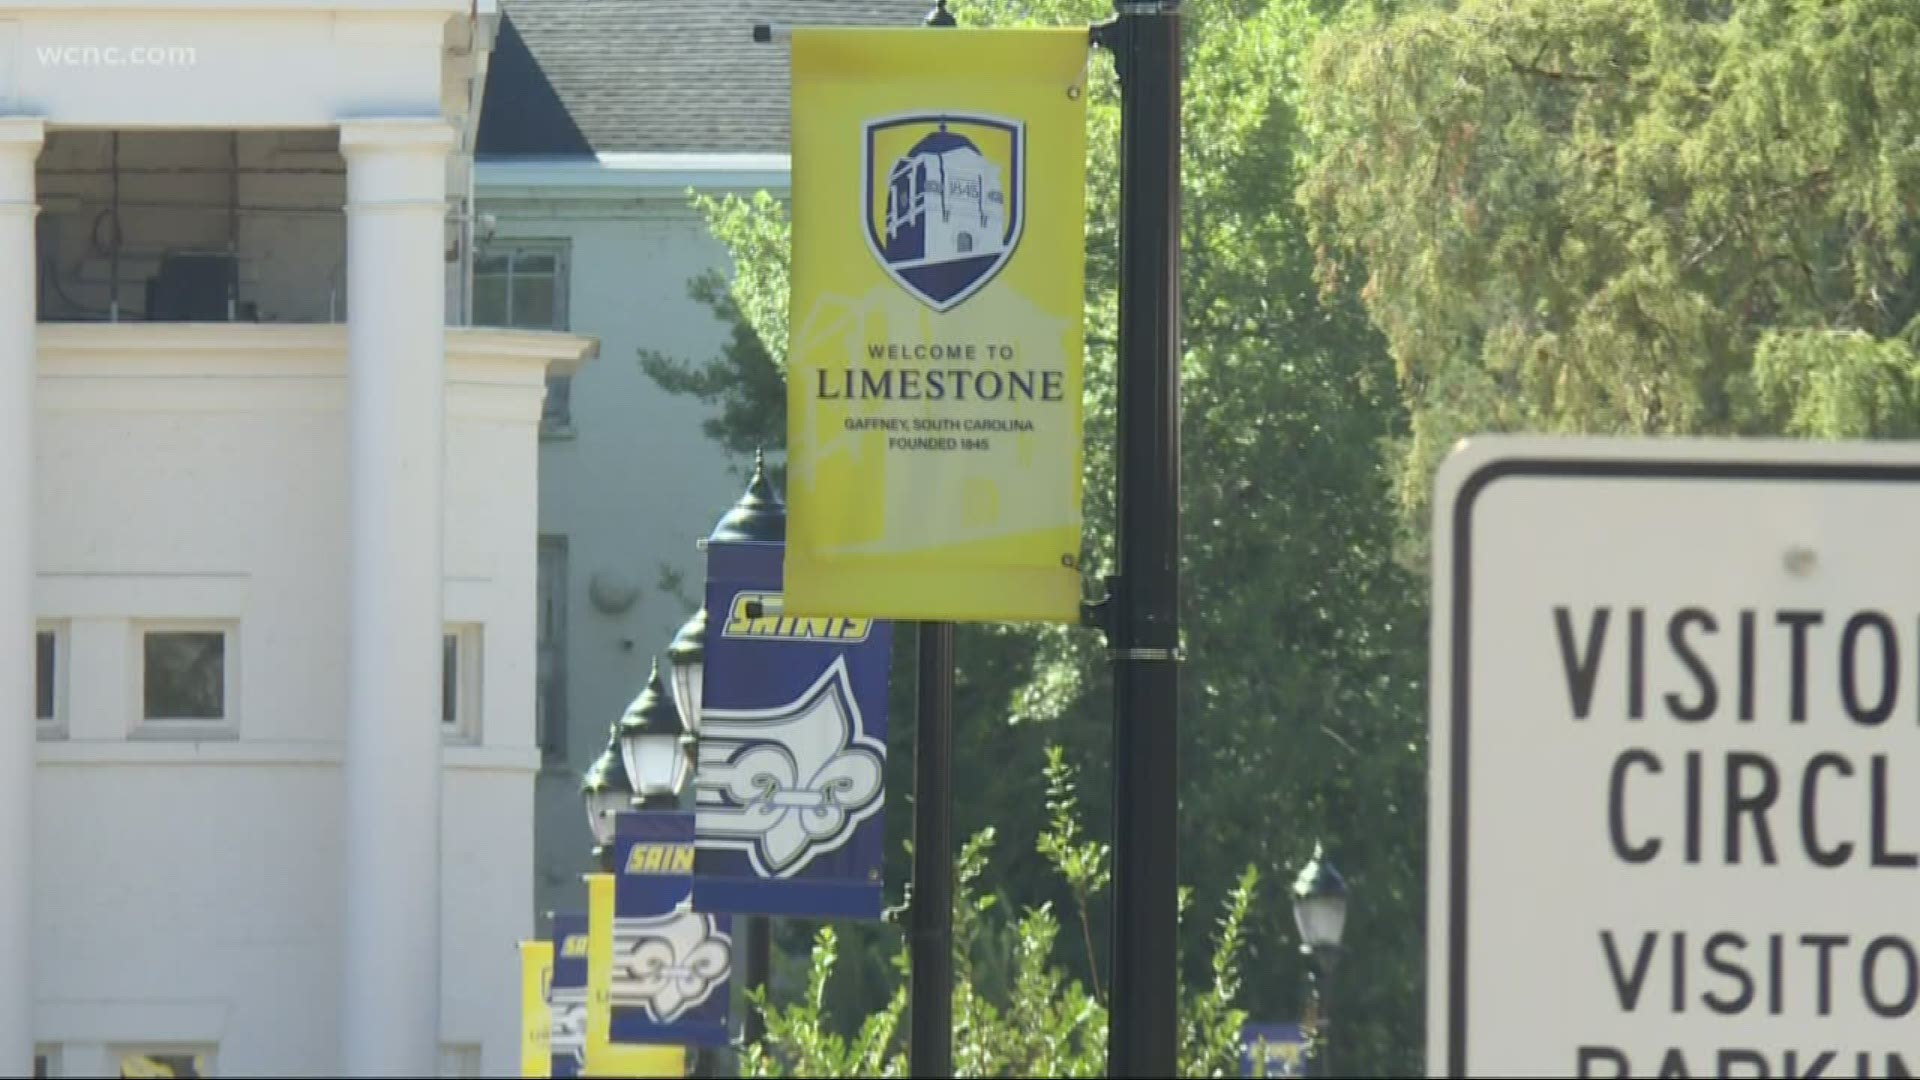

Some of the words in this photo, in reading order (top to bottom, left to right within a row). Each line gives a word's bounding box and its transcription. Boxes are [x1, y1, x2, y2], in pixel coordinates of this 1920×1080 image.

[868, 344, 977, 360] WELCOME
[988, 345, 1014, 360] TO
[816, 368, 1064, 402] LIMESTONE
[844, 418, 909, 432] GAFFNEY,
[912, 418, 960, 432] SOUTH
[963, 419, 1034, 432] CAROLINA
[889, 437, 957, 450] FOUNDED
[961, 438, 989, 451] 1845
[1554, 606, 1920, 727] VISITO
